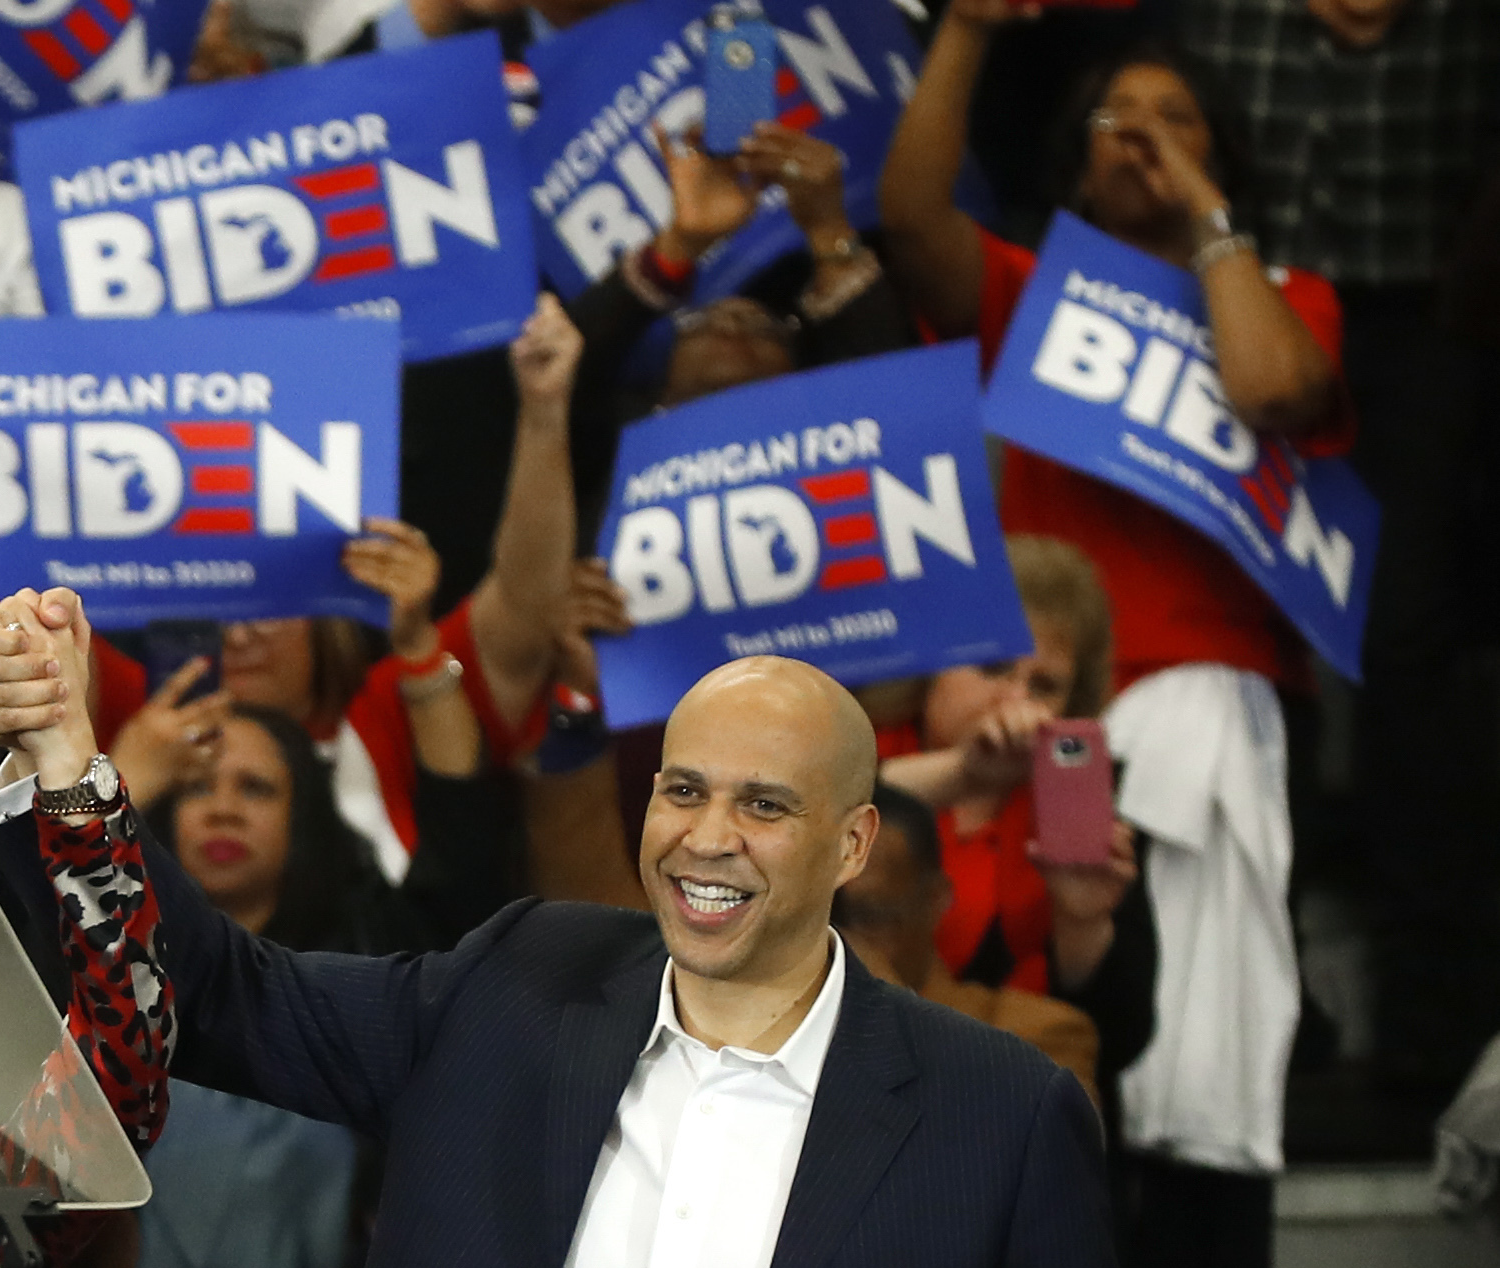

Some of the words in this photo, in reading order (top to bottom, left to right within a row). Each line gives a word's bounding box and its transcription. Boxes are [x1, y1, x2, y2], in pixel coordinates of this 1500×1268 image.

[51, 130, 288, 212] MICHIGAN
[291, 112, 390, 166] FOR
[59, 138, 500, 319] BIDEN
[172, 371, 274, 414] FOR
[622, 431, 800, 508] MICHIGAN
[801, 417, 883, 468] FOR
[610, 452, 977, 628] BIDEN
